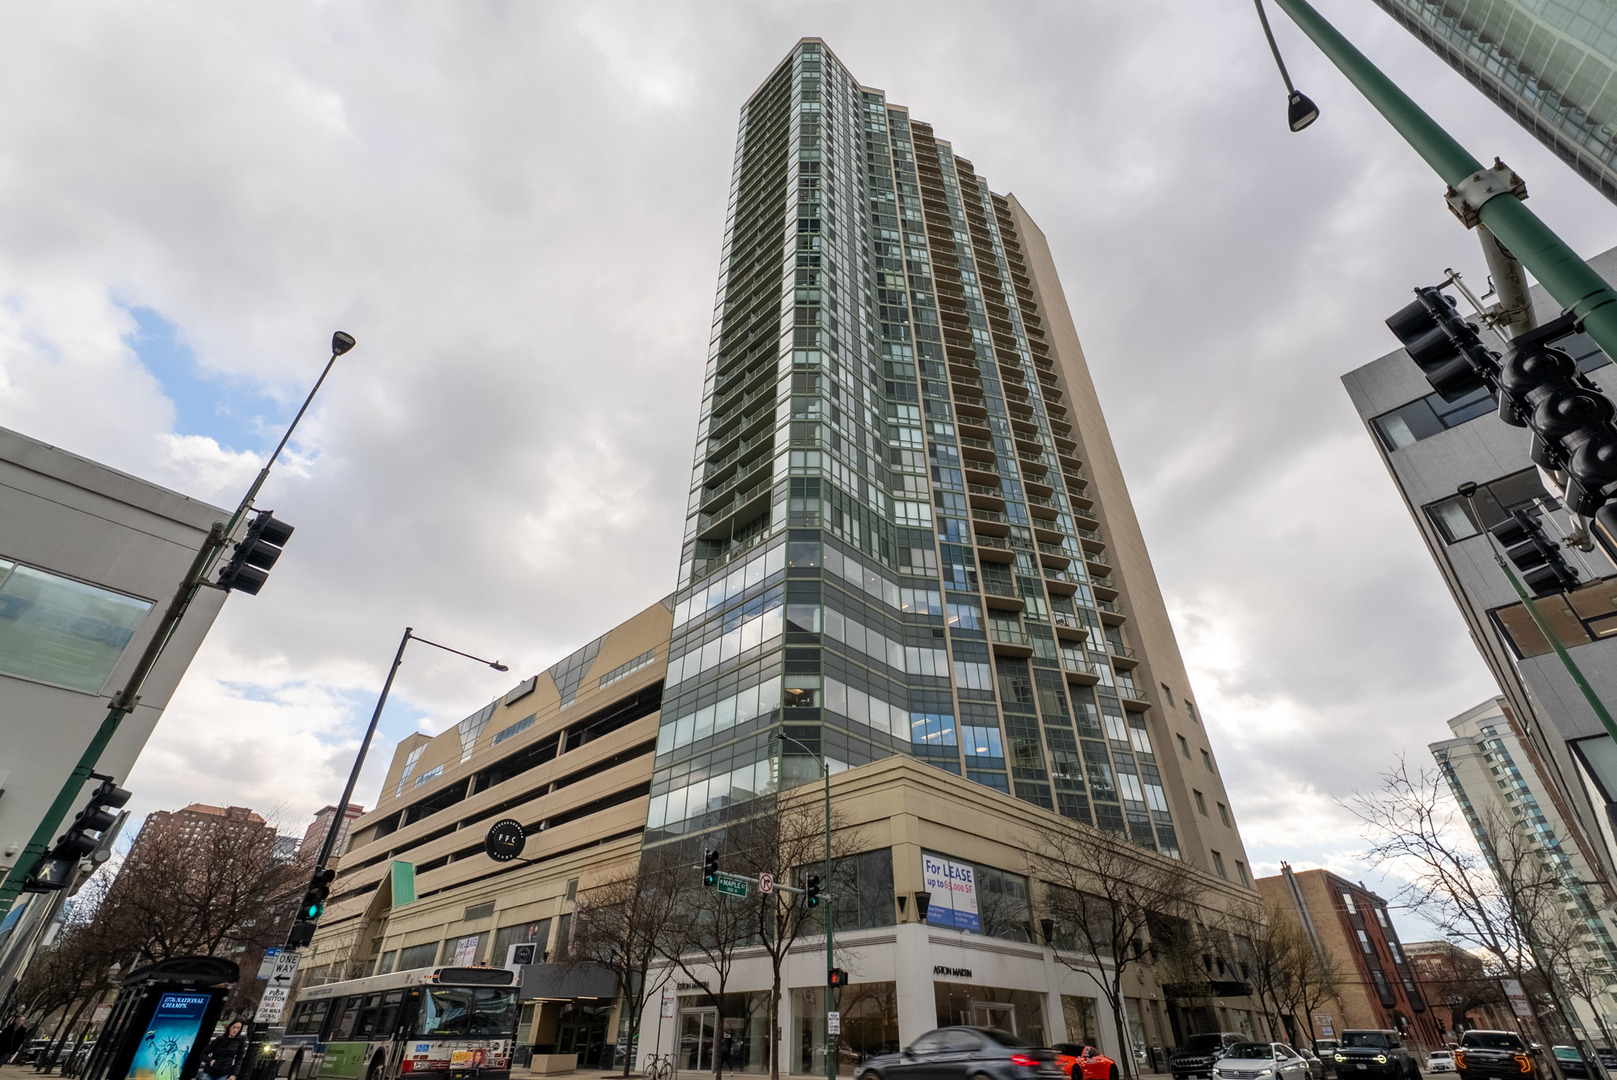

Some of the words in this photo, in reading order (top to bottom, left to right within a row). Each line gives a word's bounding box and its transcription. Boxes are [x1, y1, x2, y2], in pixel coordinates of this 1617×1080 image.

[498, 833, 516, 844] FFC
[926, 859, 941, 875] For
[942, 863, 972, 883] LEASE
[723, 878, 741, 889] MAPLE
[927, 878, 936, 888] up
[937, 879, 944, 888] to
[964, 883, 972, 894] SF
[279, 954, 298, 964] ONE
[275, 964, 296, 973] WAY
[933, 965, 952, 976] ASTON
[952, 967, 972, 978] MARTIN
